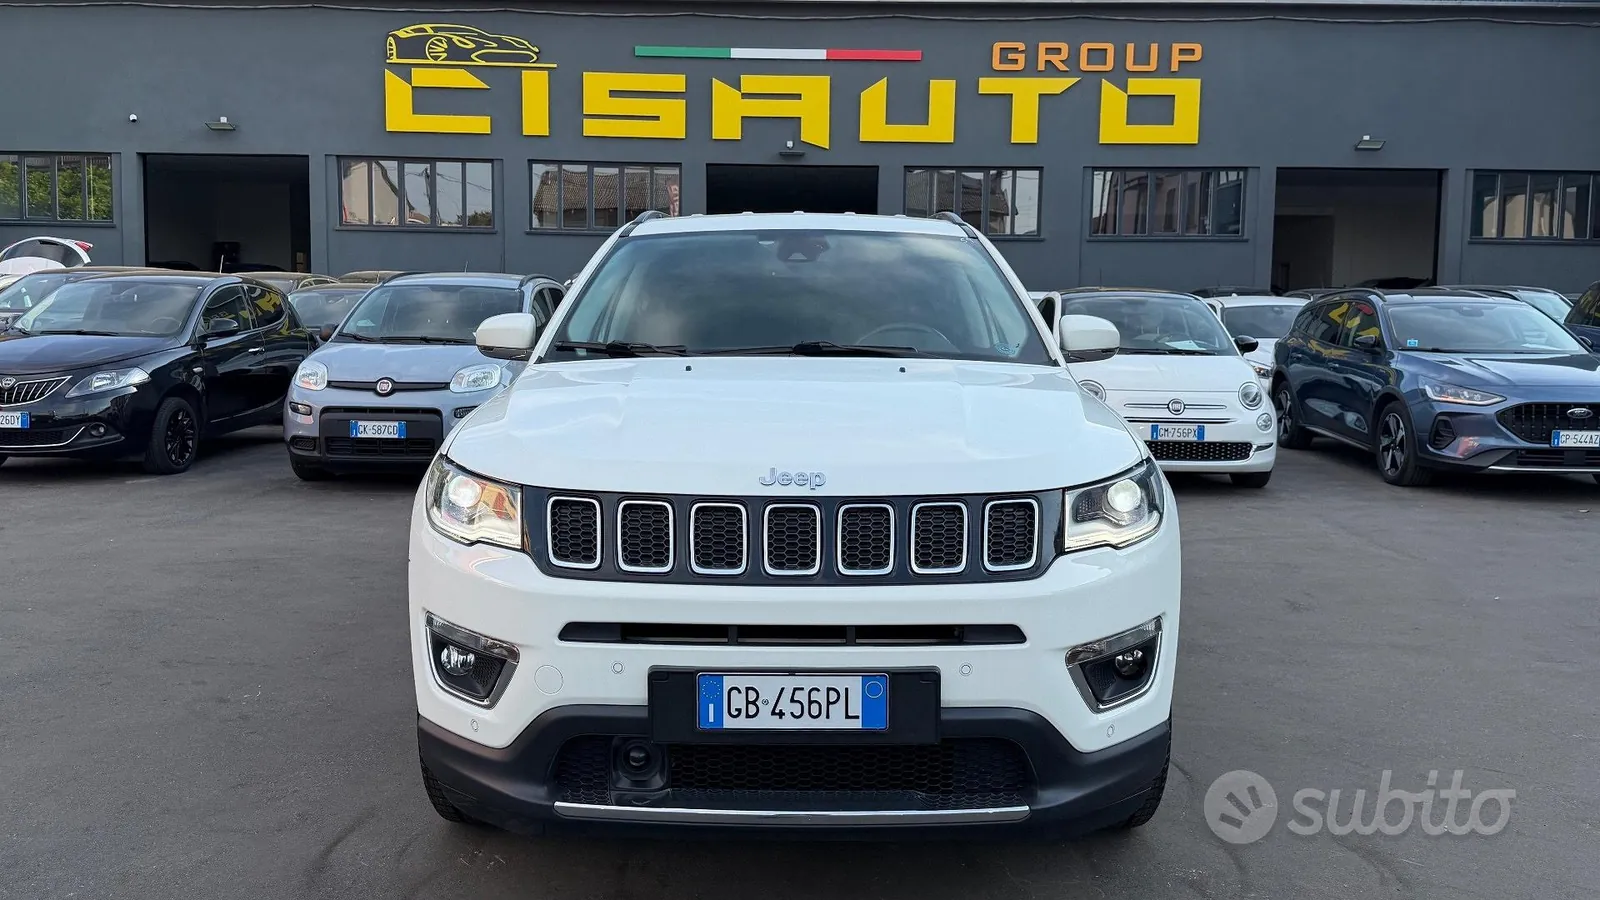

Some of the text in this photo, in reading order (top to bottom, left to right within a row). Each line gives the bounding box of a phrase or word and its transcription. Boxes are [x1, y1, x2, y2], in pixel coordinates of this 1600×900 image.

[991, 41, 1202, 72] GROUP
[385, 67, 1201, 150] CISAUTO
[758, 467, 827, 490] Jeep
